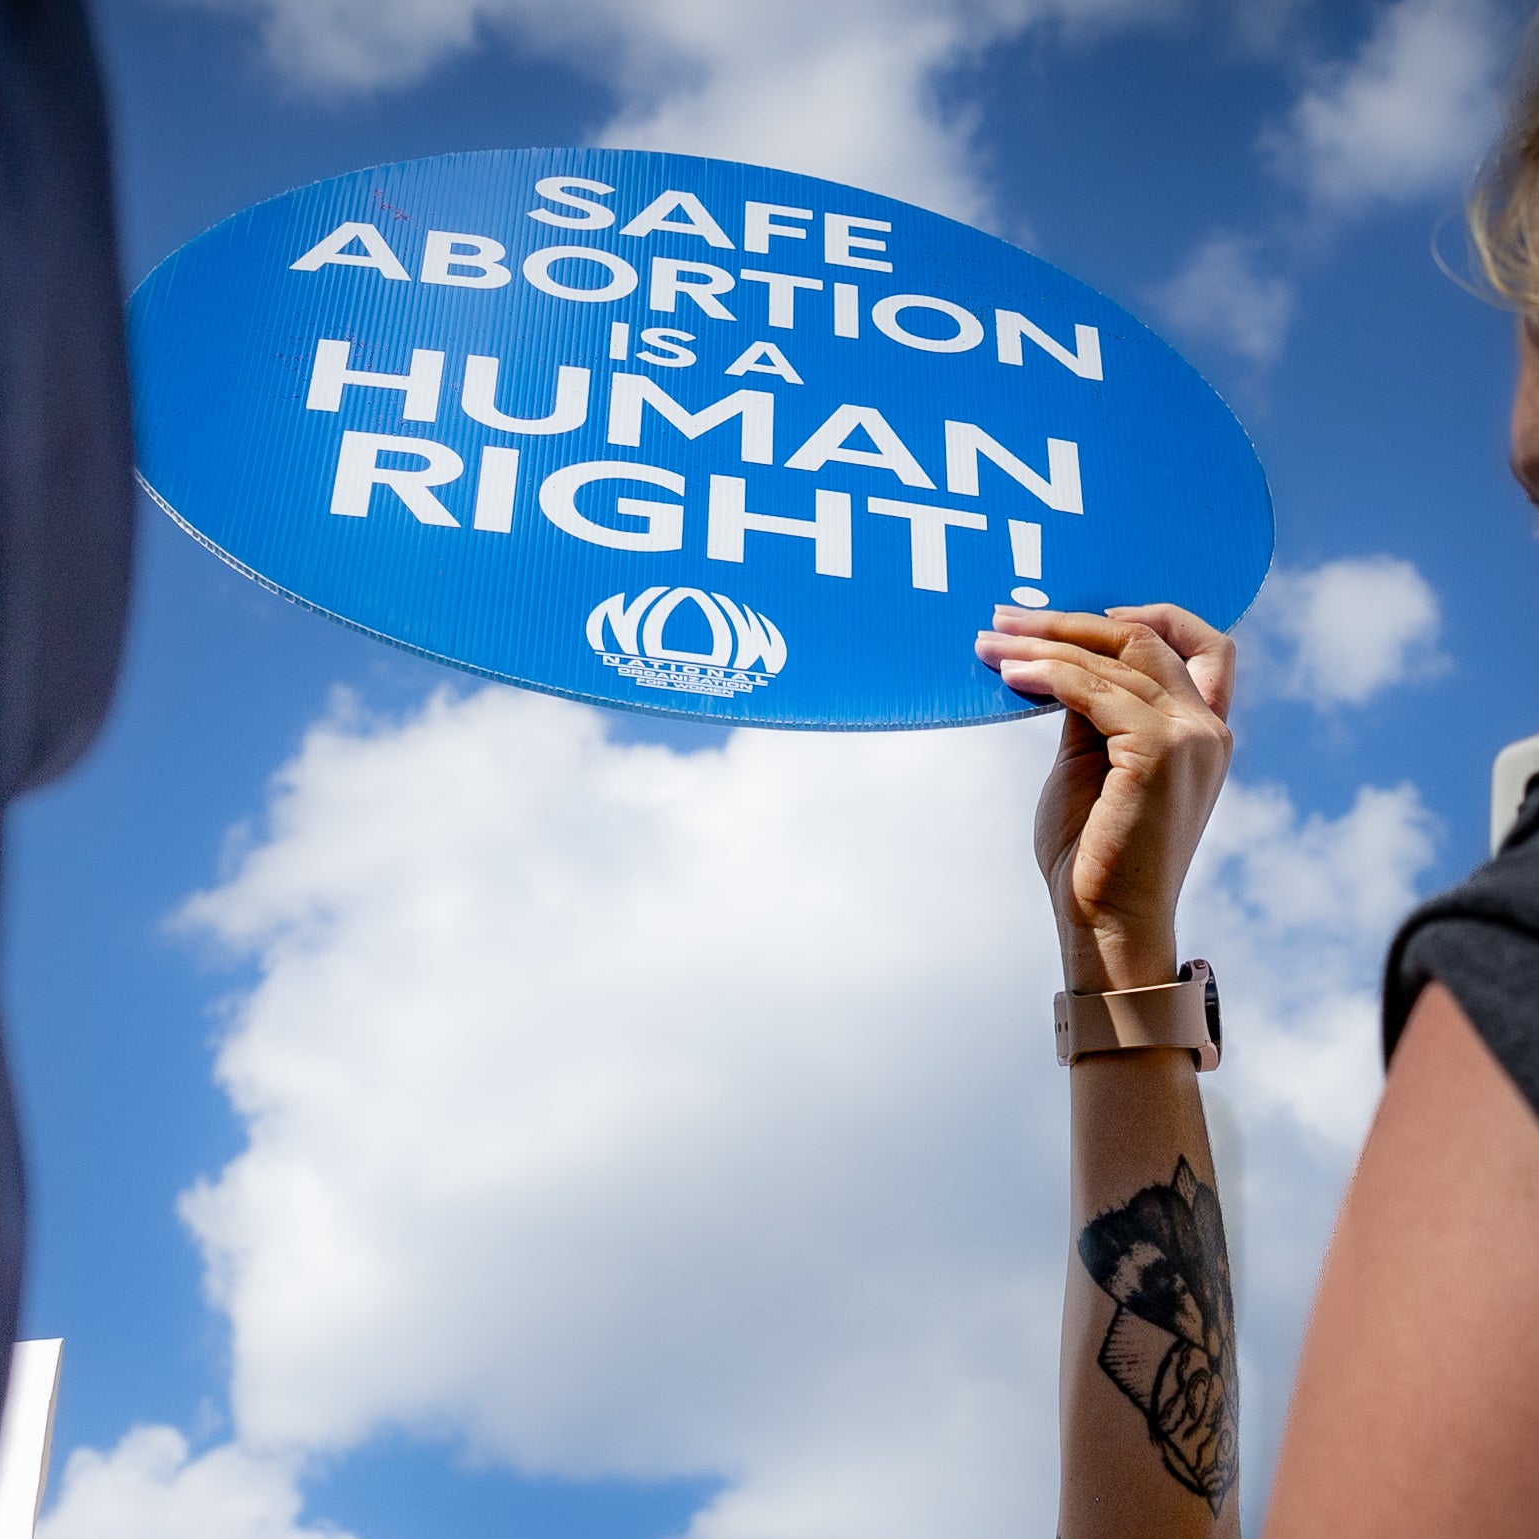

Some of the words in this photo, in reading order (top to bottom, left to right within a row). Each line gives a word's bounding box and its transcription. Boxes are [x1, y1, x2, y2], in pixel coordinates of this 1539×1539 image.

[526, 174, 895, 275] SAFE
[289, 219, 1105, 383] ABORTION
[609, 319, 699, 370] IS
[723, 340, 805, 387] A
[305, 337, 1086, 516] HUMAN
[328, 429, 1052, 611] RIGHT!
[586, 586, 788, 675] NOW
[603, 655, 769, 684] NATIONAL
[617, 668, 753, 690] ORGANIZATION
[637, 677, 668, 688] FOR
[671, 681, 735, 697] WOMEN
